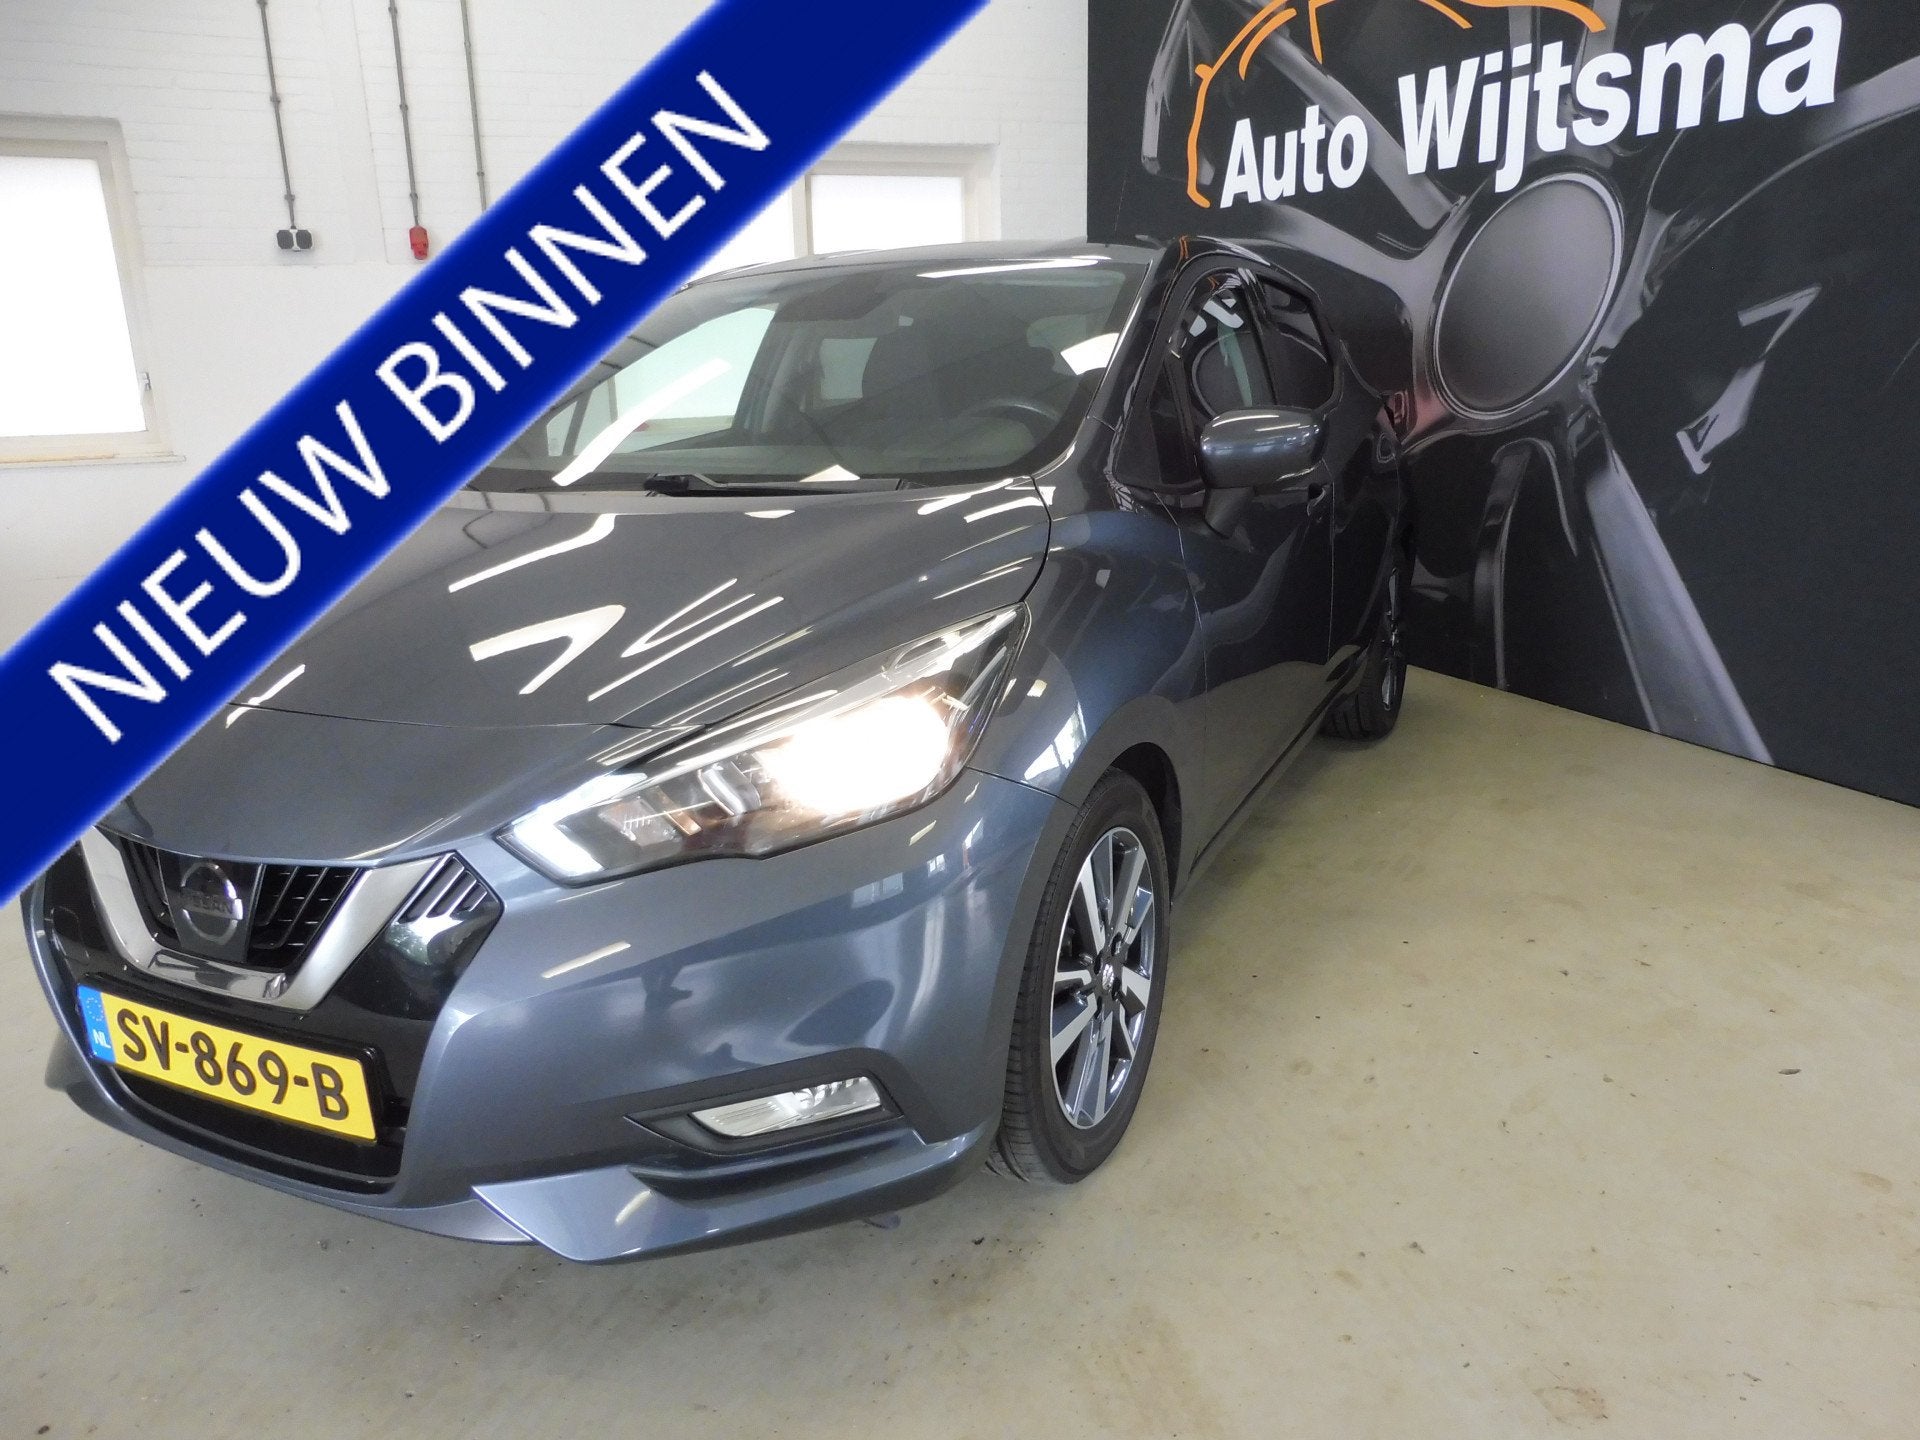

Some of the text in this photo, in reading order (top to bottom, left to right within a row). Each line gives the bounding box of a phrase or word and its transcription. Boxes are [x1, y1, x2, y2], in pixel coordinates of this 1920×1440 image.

[1219, 3, 1842, 209] Auto Wijtsma
[92, 1028, 111, 1049] NL
[117, 1008, 349, 1121] SV-869-B
